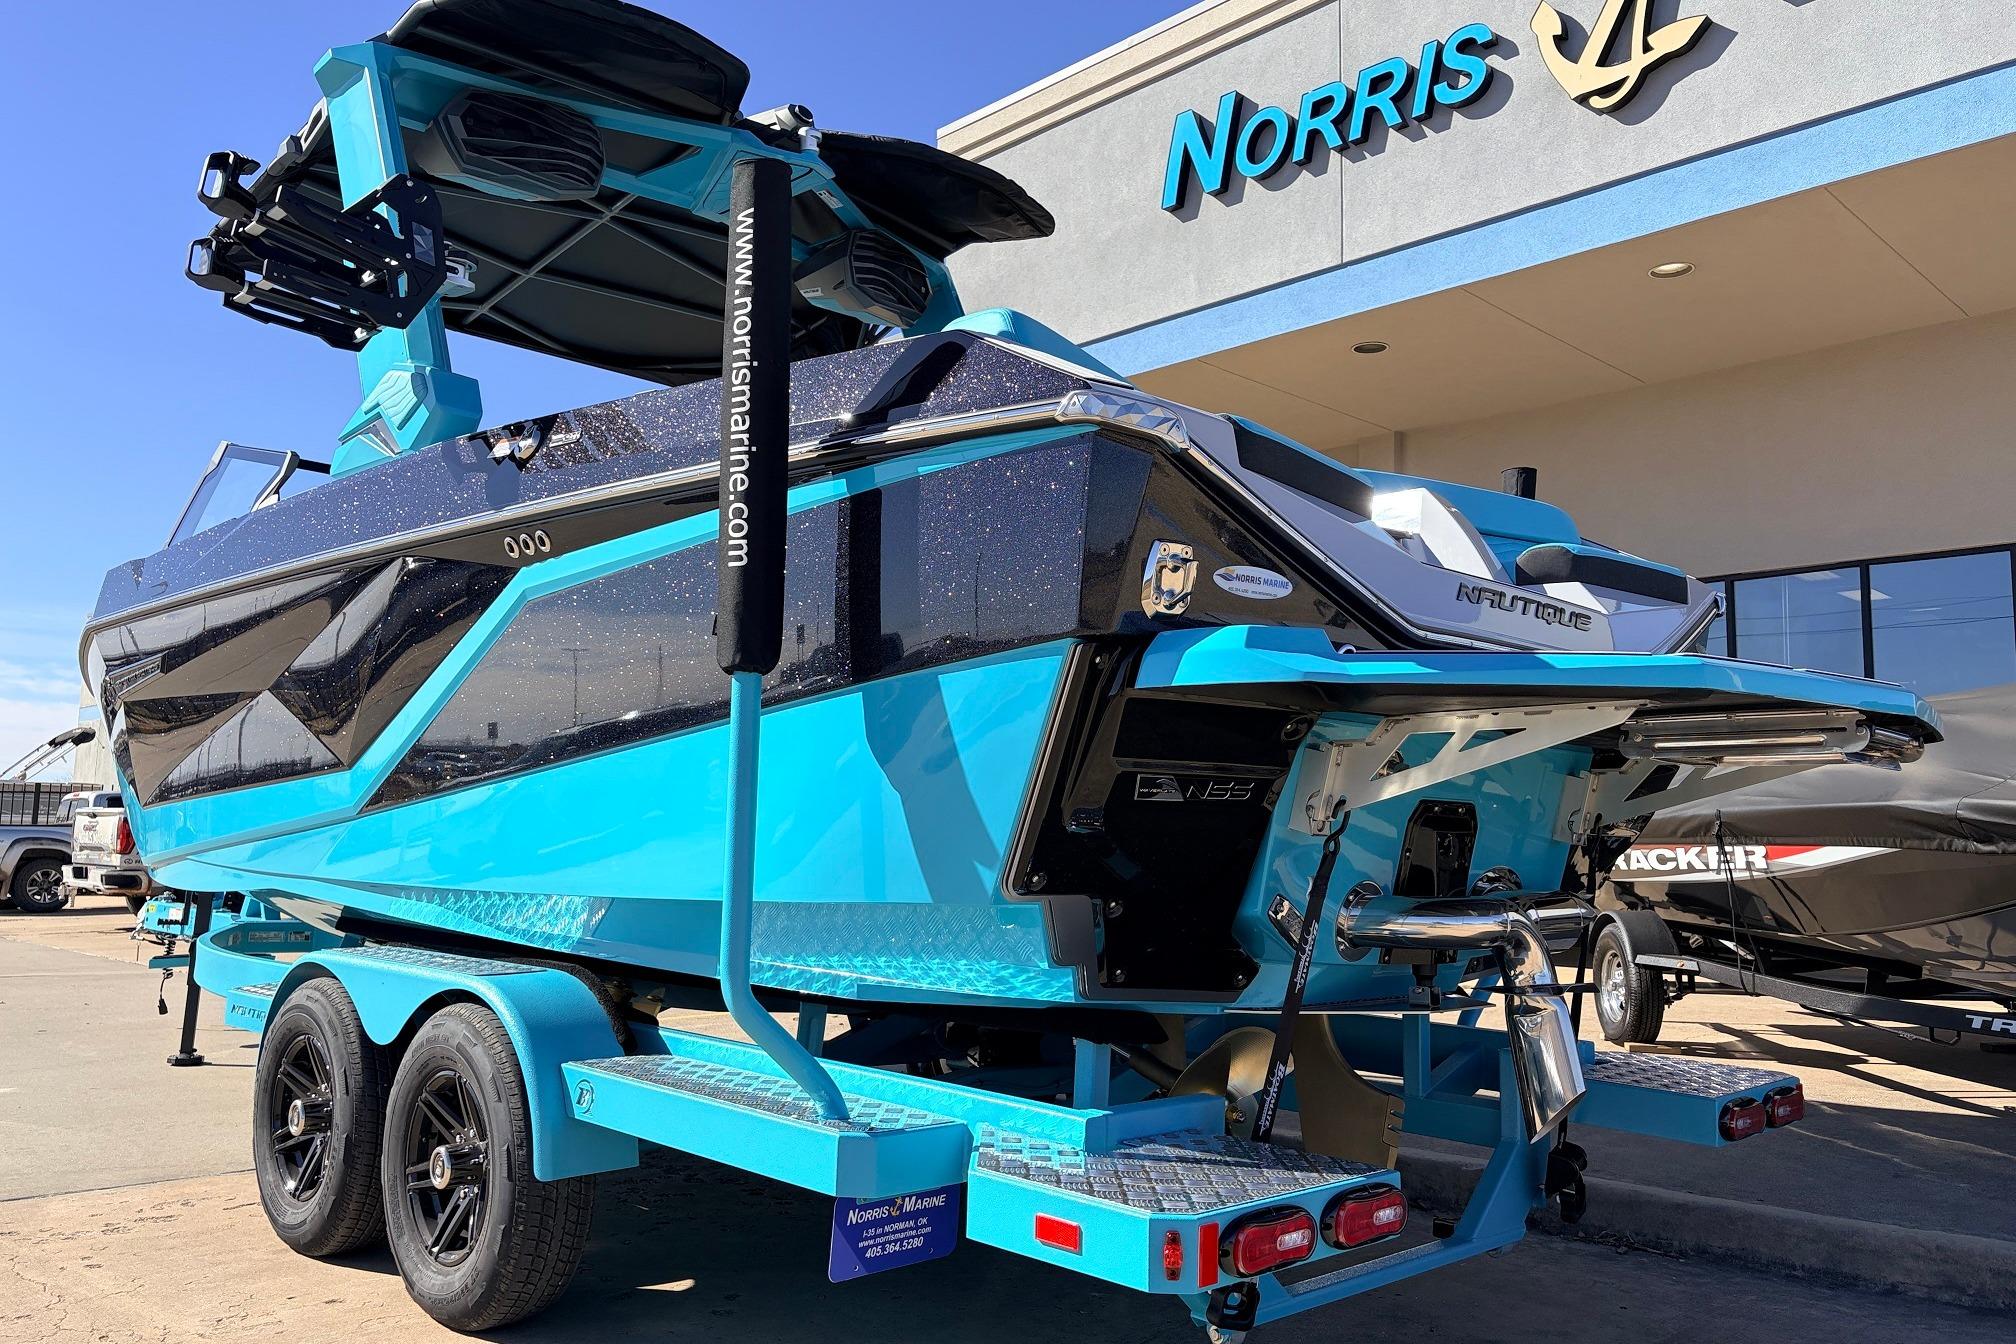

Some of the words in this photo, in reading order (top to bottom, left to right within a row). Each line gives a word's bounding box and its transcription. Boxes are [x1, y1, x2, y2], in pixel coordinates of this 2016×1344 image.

[1161, 22, 1499, 211] NORRIS
[728, 207, 757, 568] www.norrismarine.com
[1235, 573, 1262, 585] NORRIS
[1262, 577, 1290, 590] MARINE
[1456, 581, 1592, 632] NAUTIQUE
[846, 1205, 890, 1226] NORRIS
[902, 1194, 946, 1213] MARINE
[858, 1226, 932, 1248] www.norrismarine.com
[883, 1220, 916, 1233] NORMAN,
[917, 1217, 928, 1226] OK
[864, 1236, 924, 1259] 405.364.5280
